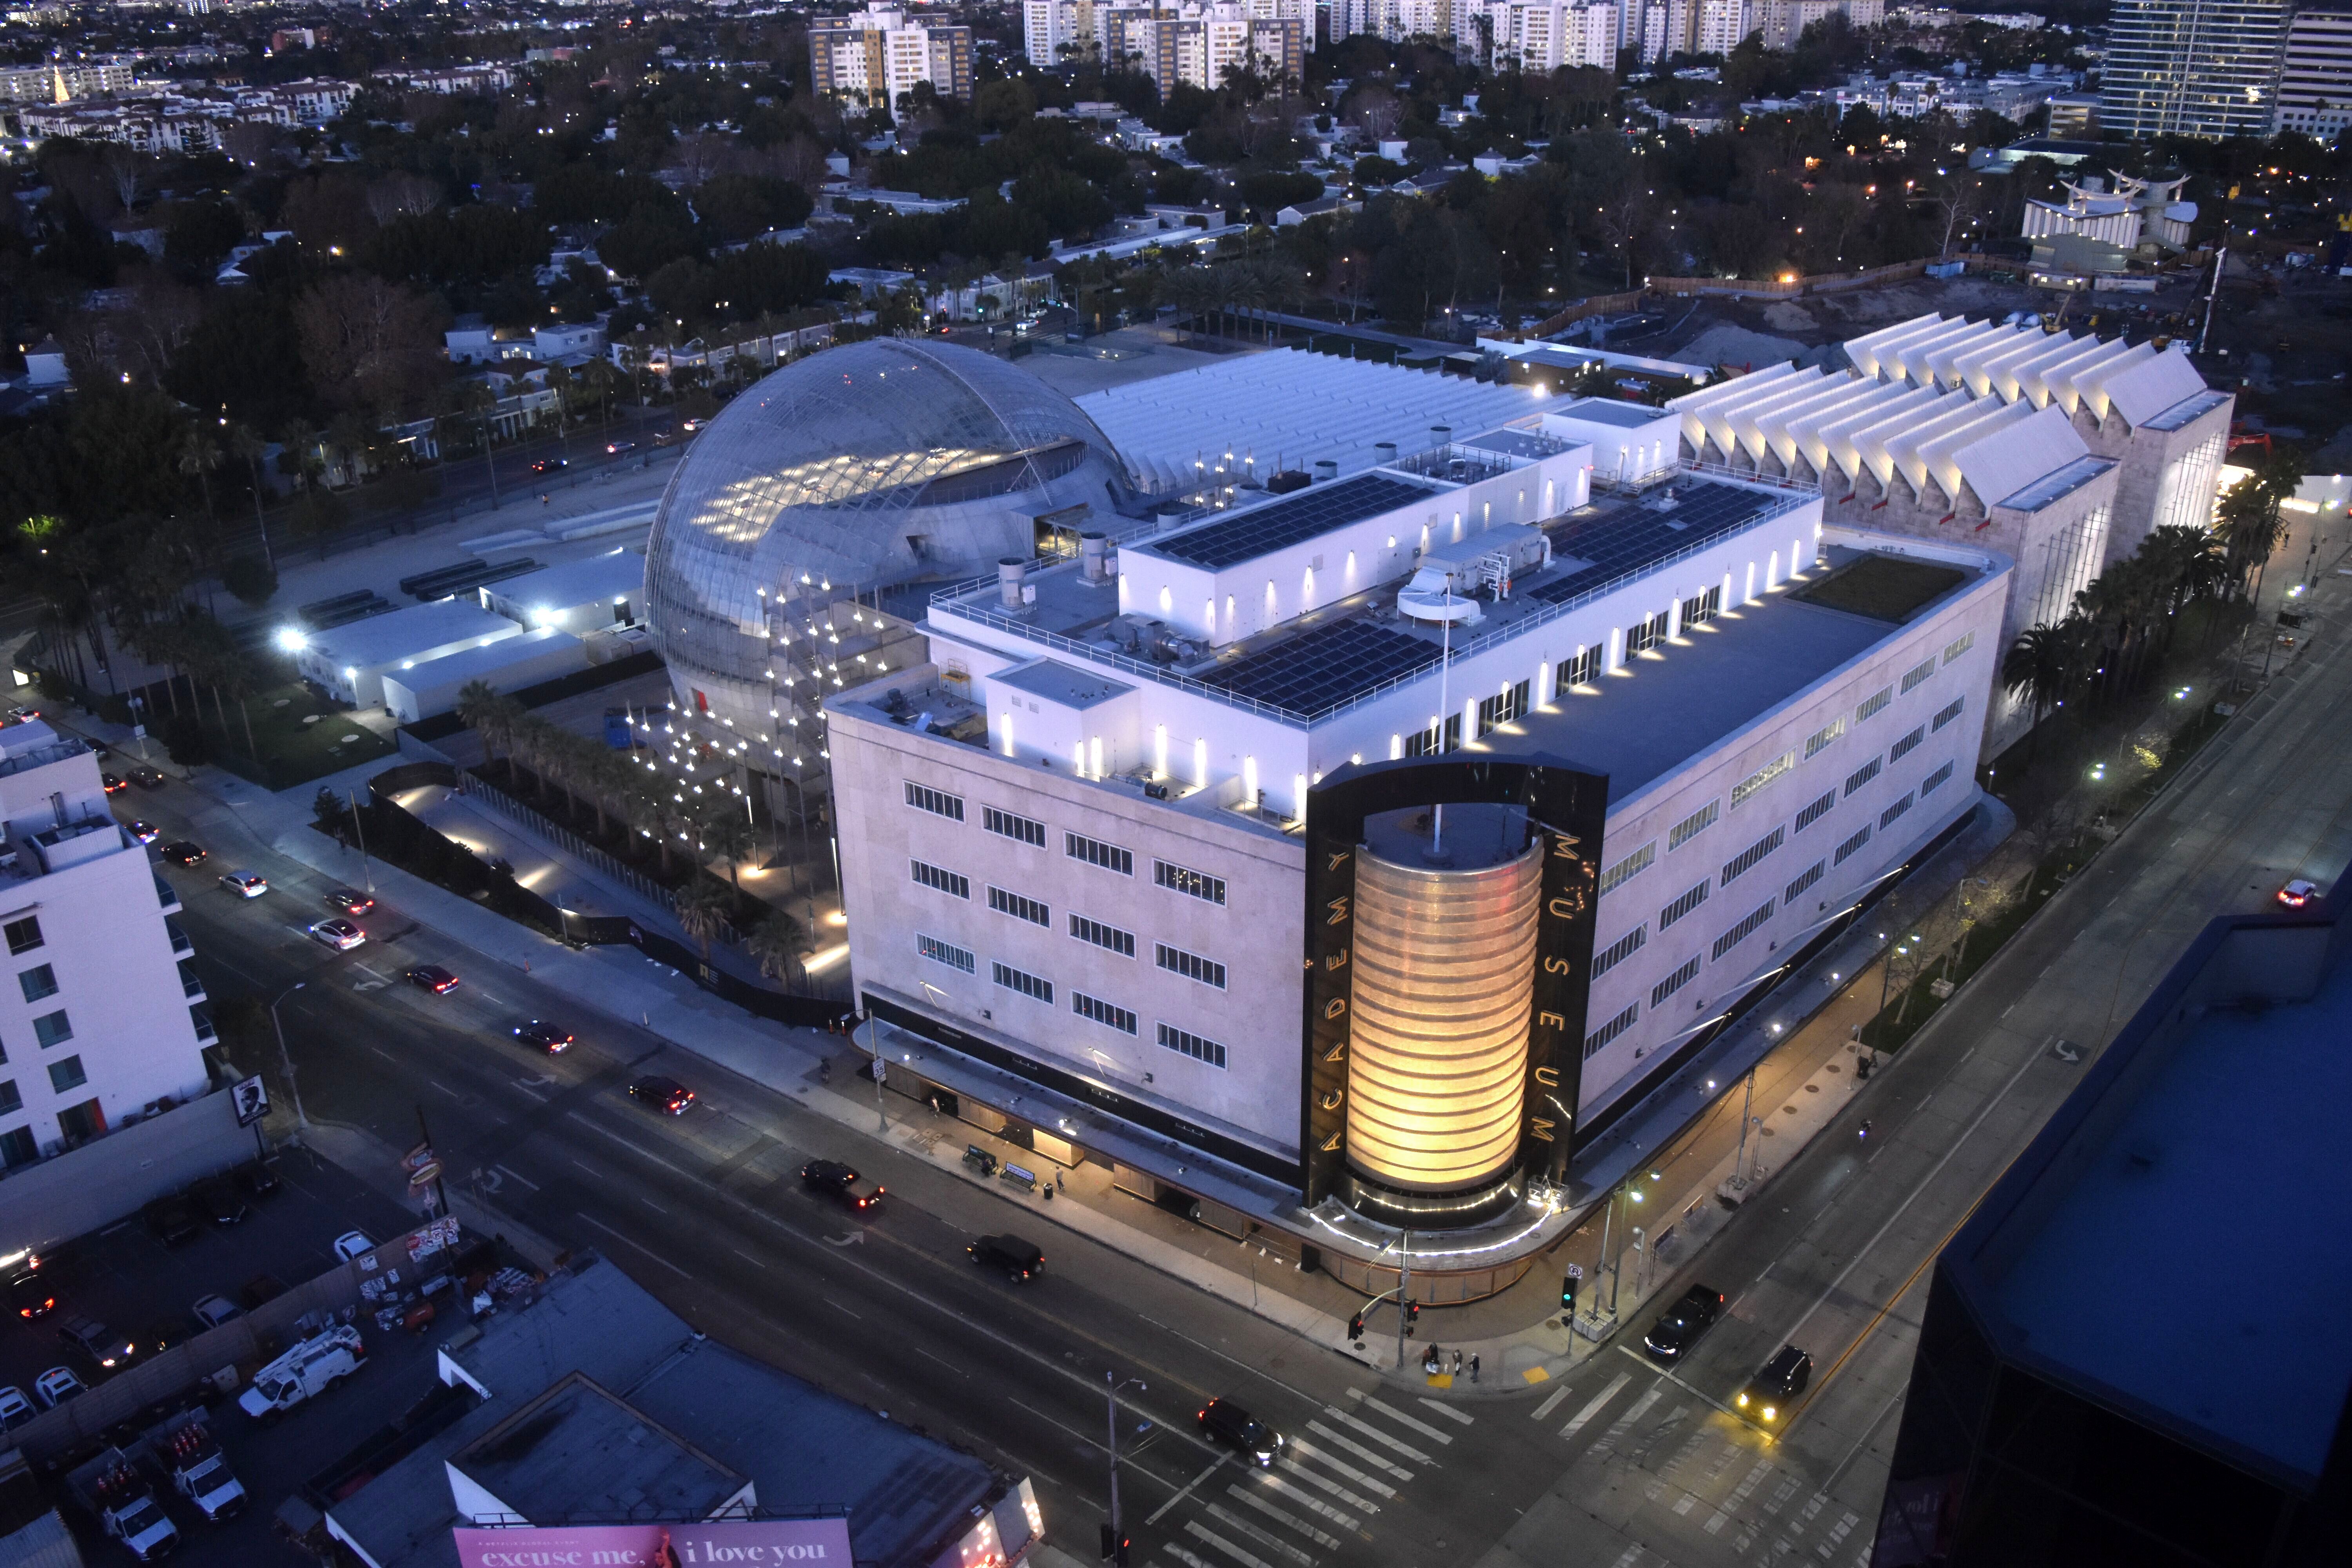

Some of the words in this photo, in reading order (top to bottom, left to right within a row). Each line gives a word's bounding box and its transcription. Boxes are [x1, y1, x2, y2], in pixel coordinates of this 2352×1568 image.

[1319, 852, 1349, 1151] ACADEMY
[1530, 834, 1581, 1142] MUSEUM
[875, 1066, 884, 1075] 35
[482, 1551, 583, 1566] excuse
[592, 1550, 646, 1566] me,
[686, 1541, 696, 1562] i
[704, 1541, 765, 1562] love
[769, 1544, 828, 1567] you
